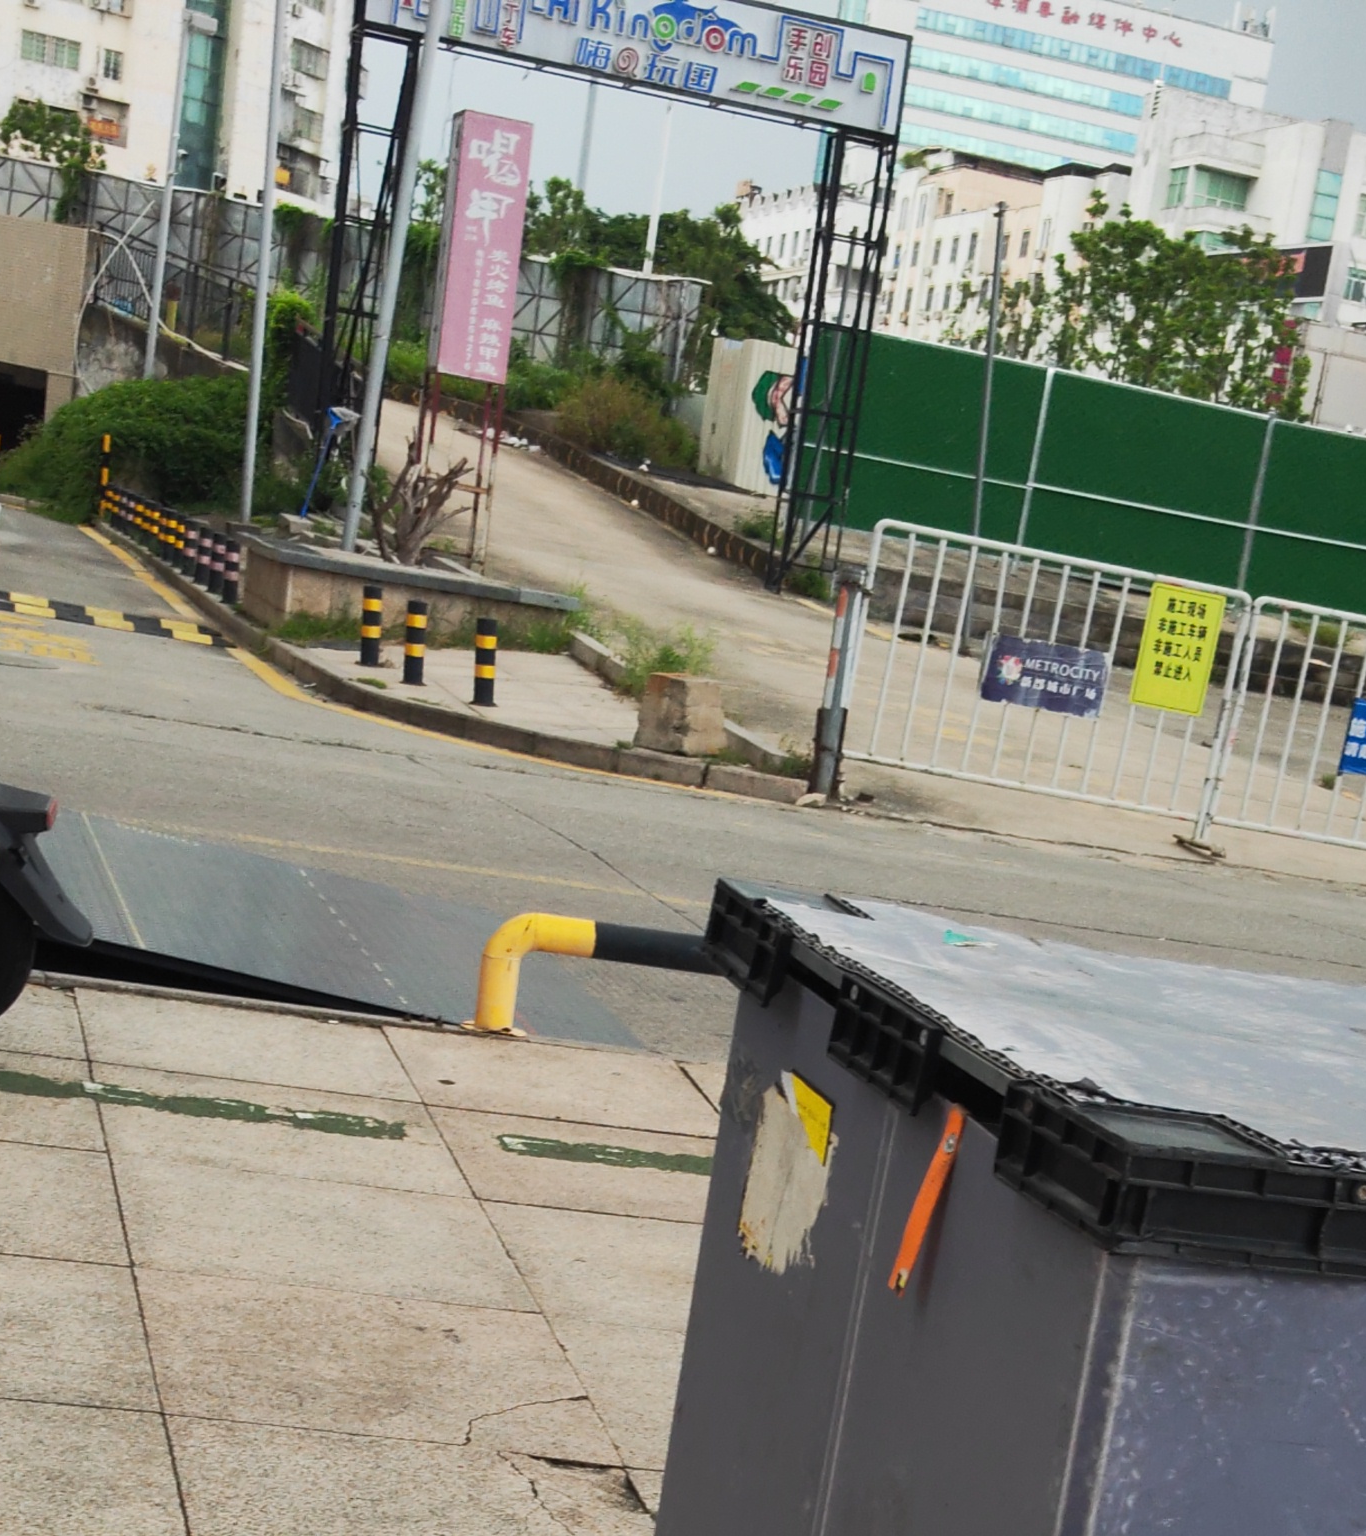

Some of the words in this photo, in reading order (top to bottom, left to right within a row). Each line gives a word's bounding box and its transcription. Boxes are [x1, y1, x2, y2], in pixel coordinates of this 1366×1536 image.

[788, 26, 835, 61] 手创
[782, 54, 830, 89] 乐园
[475, 317, 503, 376] 麻辣甲鱼
[1166, 597, 1207, 620] 施工现场
[1157, 617, 1208, 642] 非施工车辆
[1152, 638, 1203, 663] 非施工人员
[1024, 657, 1101, 682] METROCITY
[1153, 660, 1192, 682] 禁止进入
